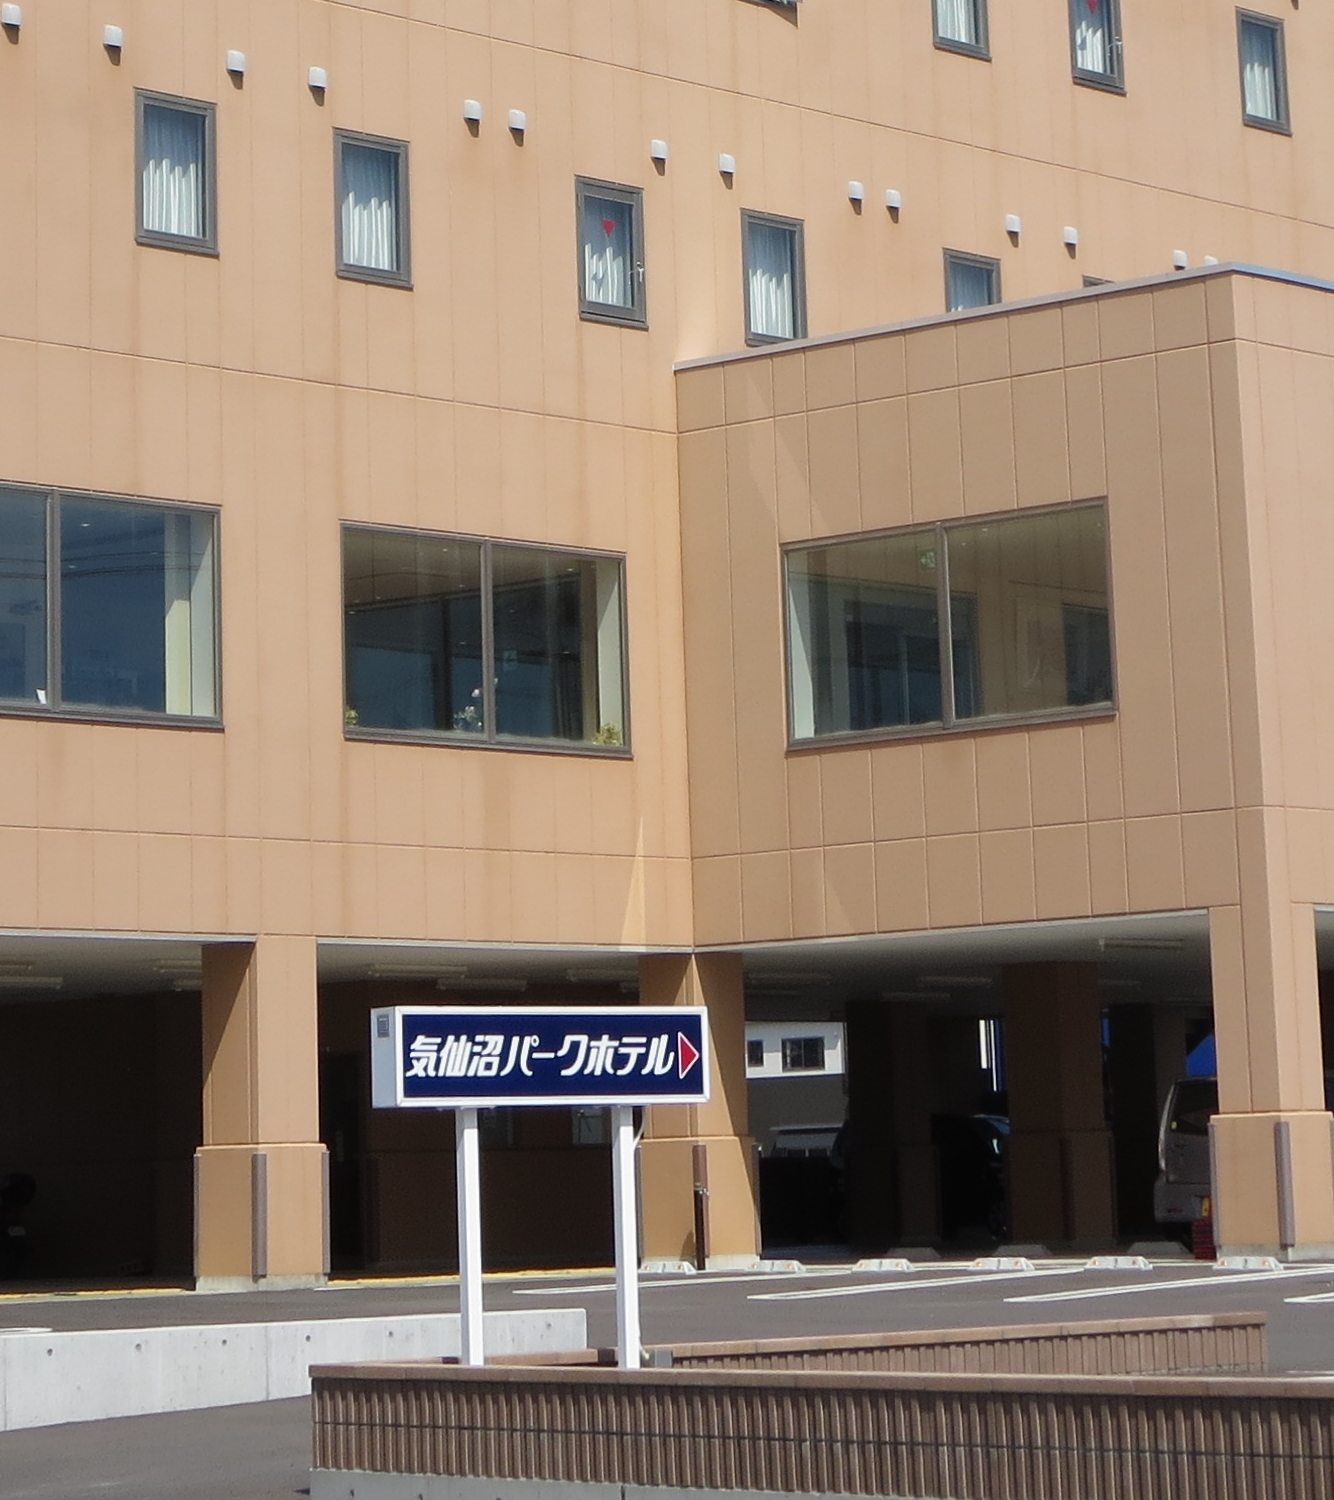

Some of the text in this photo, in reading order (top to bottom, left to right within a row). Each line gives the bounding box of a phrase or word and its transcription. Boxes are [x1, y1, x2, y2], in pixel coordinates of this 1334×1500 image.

[405, 1034, 675, 1077] 気仙沼パークホテル
